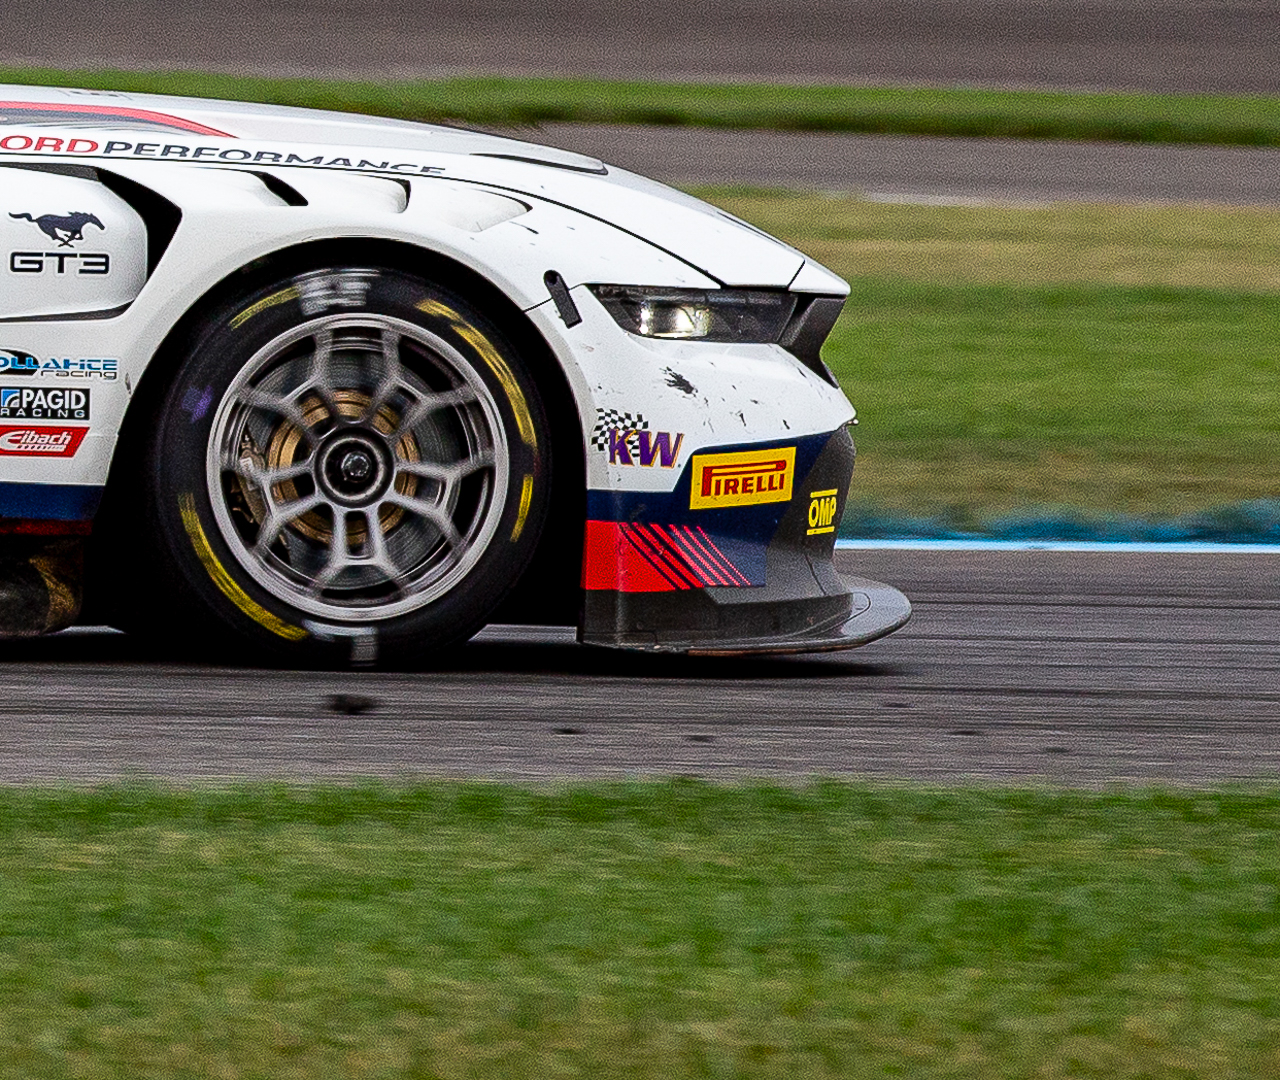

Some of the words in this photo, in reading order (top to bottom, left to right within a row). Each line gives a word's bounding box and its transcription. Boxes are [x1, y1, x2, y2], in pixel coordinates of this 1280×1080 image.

[9, 251, 110, 275] GT3
[41, 370, 117, 380] racing
[22, 390, 86, 409] PAGID
[0, 409, 85, 418] RACING
[608, 429, 684, 469] KW
[701, 459, 787, 497] PIRELLI
[809, 497, 837, 527] OMP
